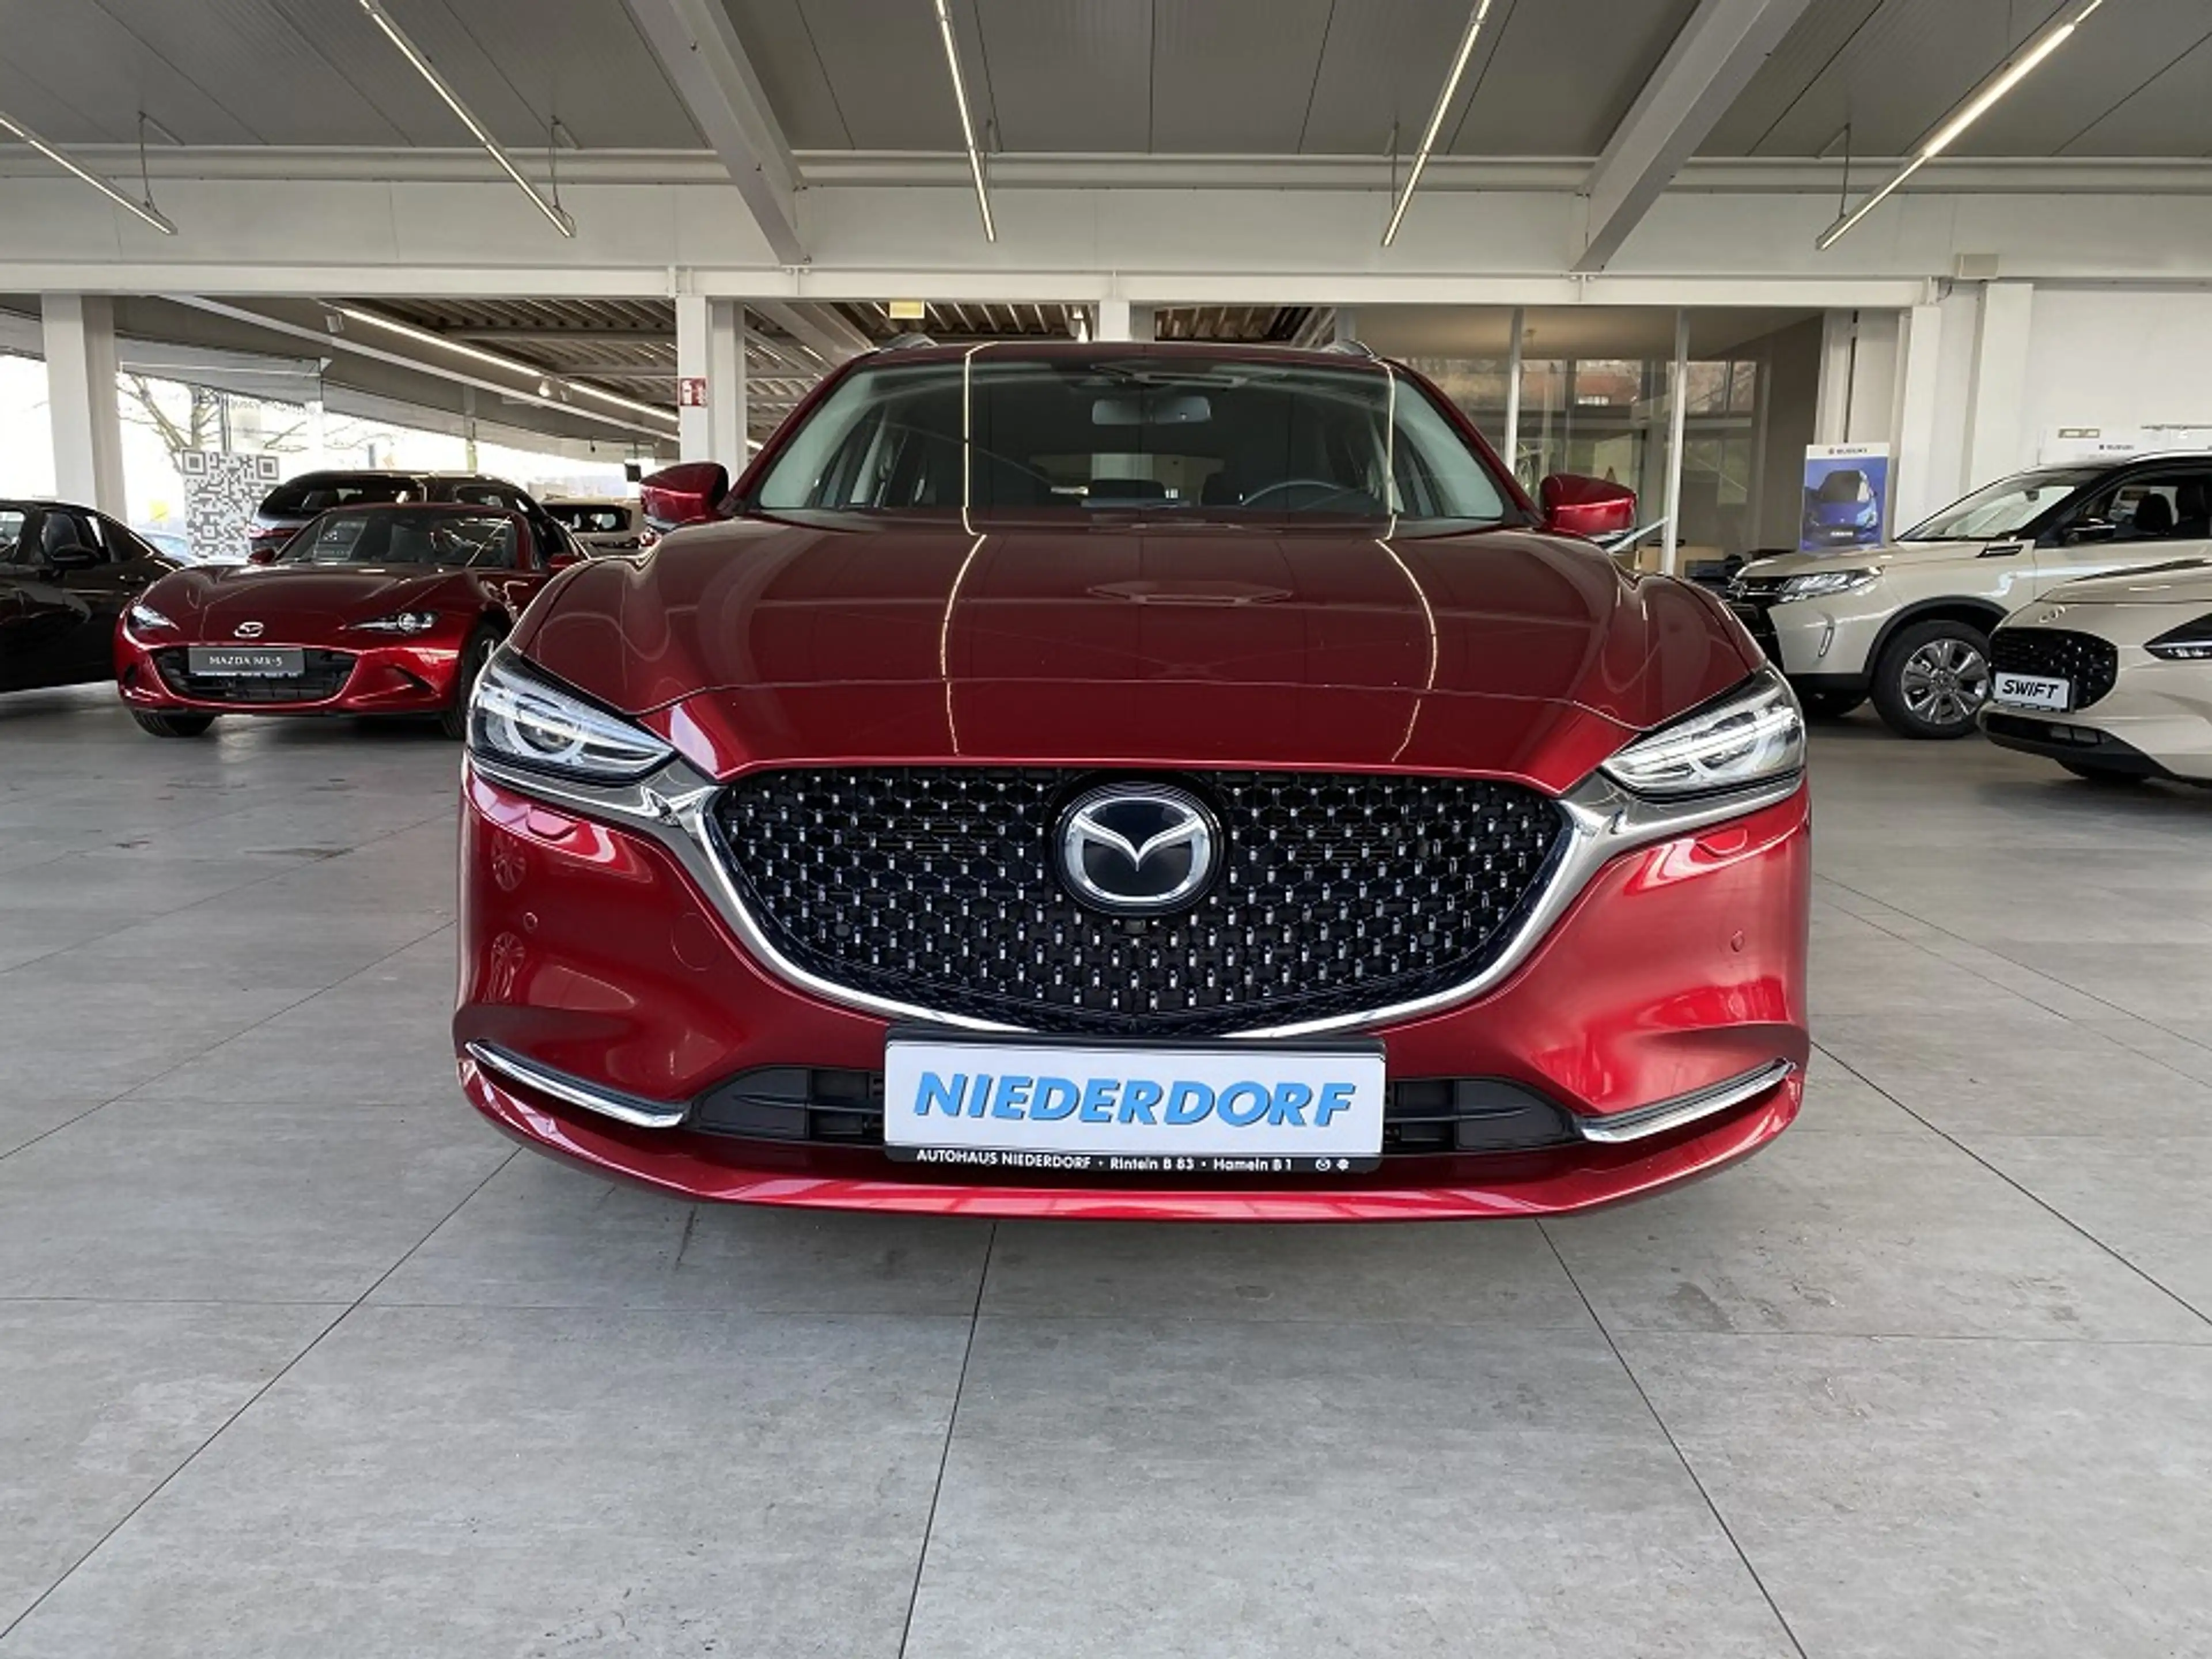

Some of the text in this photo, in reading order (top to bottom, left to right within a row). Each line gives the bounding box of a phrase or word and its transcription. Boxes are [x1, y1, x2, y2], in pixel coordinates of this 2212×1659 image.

[209, 656, 282, 667] MAZDA MX-5
[2002, 679, 2059, 699] SWIFT
[913, 1071, 1356, 1127] NIEDERDORF
[916, 1150, 998, 1165] AUTOHAUS
[1001, 1152, 1092, 1169] NIEDERDORF
[1163, 1157, 1172, 1170] B
